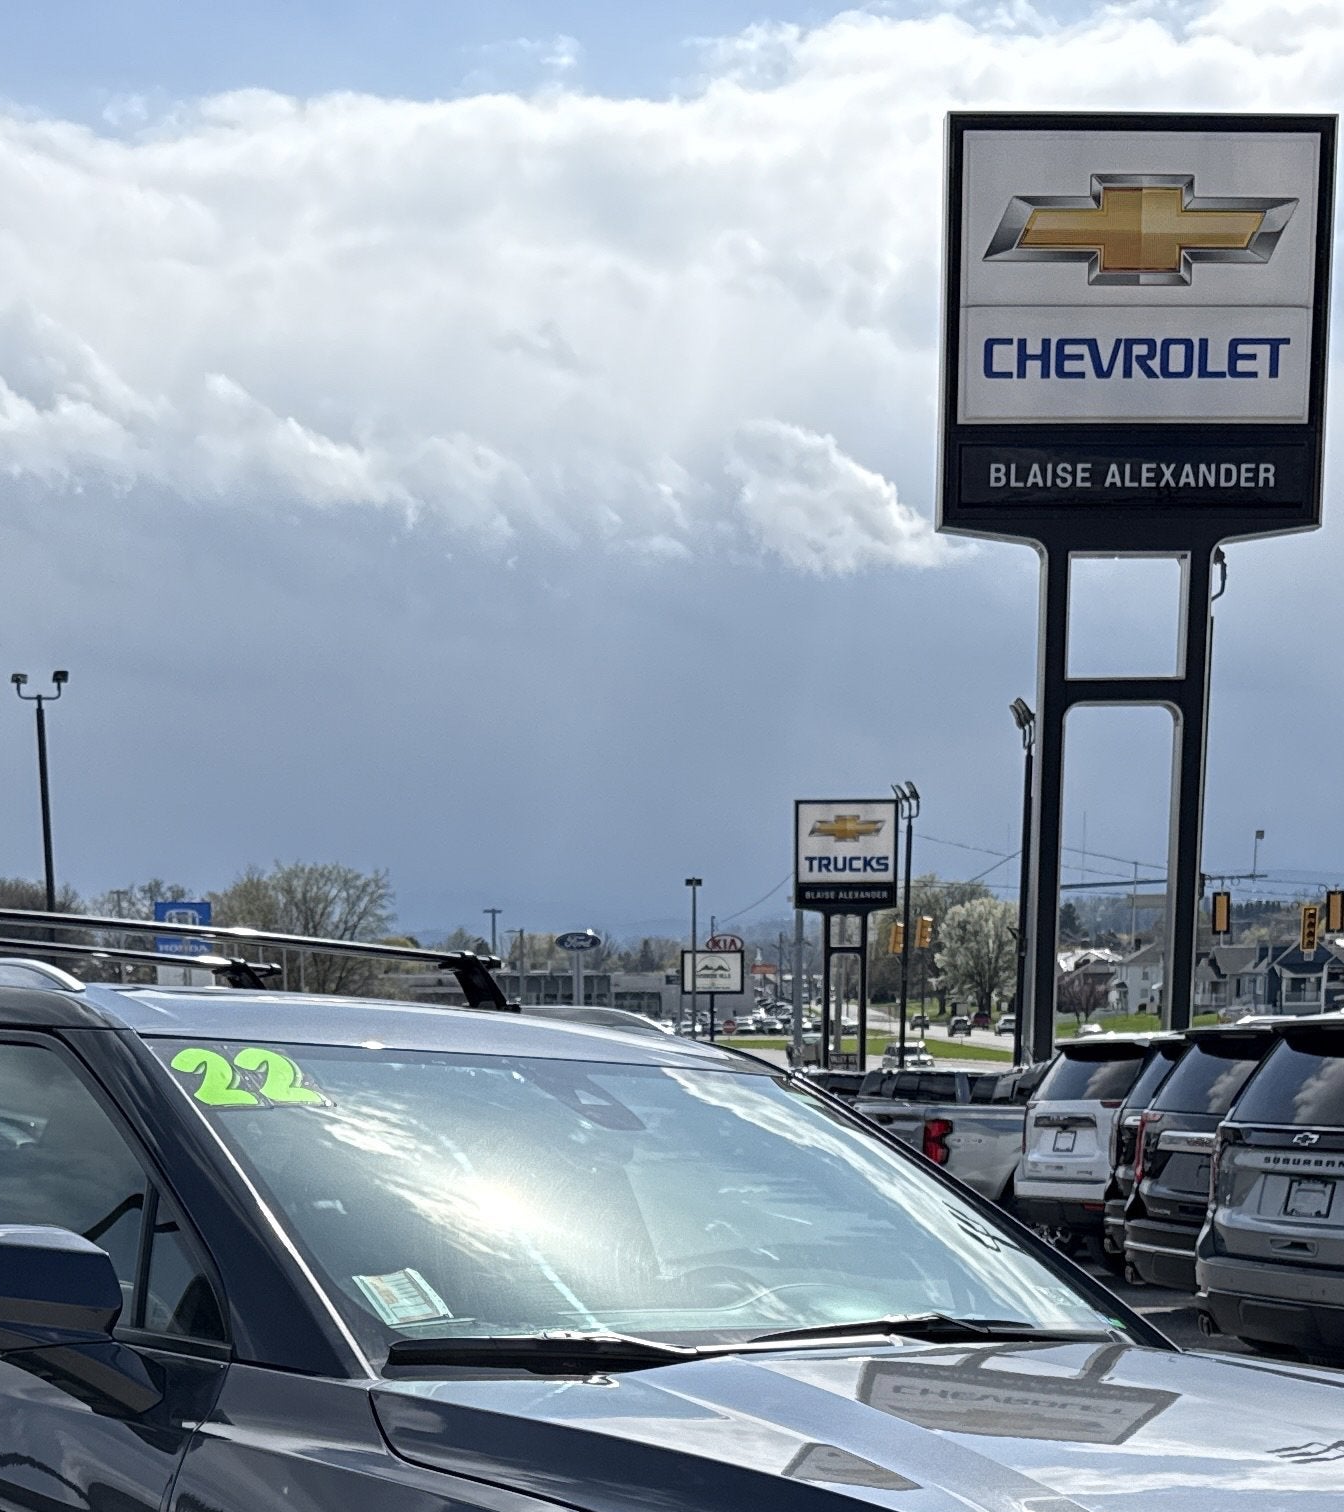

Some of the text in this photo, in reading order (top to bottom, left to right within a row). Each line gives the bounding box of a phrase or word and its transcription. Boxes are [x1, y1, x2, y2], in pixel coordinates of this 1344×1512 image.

[983, 337, 1291, 379] CHEVROLET
[989, 463, 1276, 488] BLAISE ALEXANDER
[804, 856, 890, 873] TRUCKS
[805, 891, 889, 900] BLAISE ALEXANDER
[563, 935, 593, 949] Ford
[711, 938, 737, 950] KIA
[170, 1047, 324, 1106] 22
